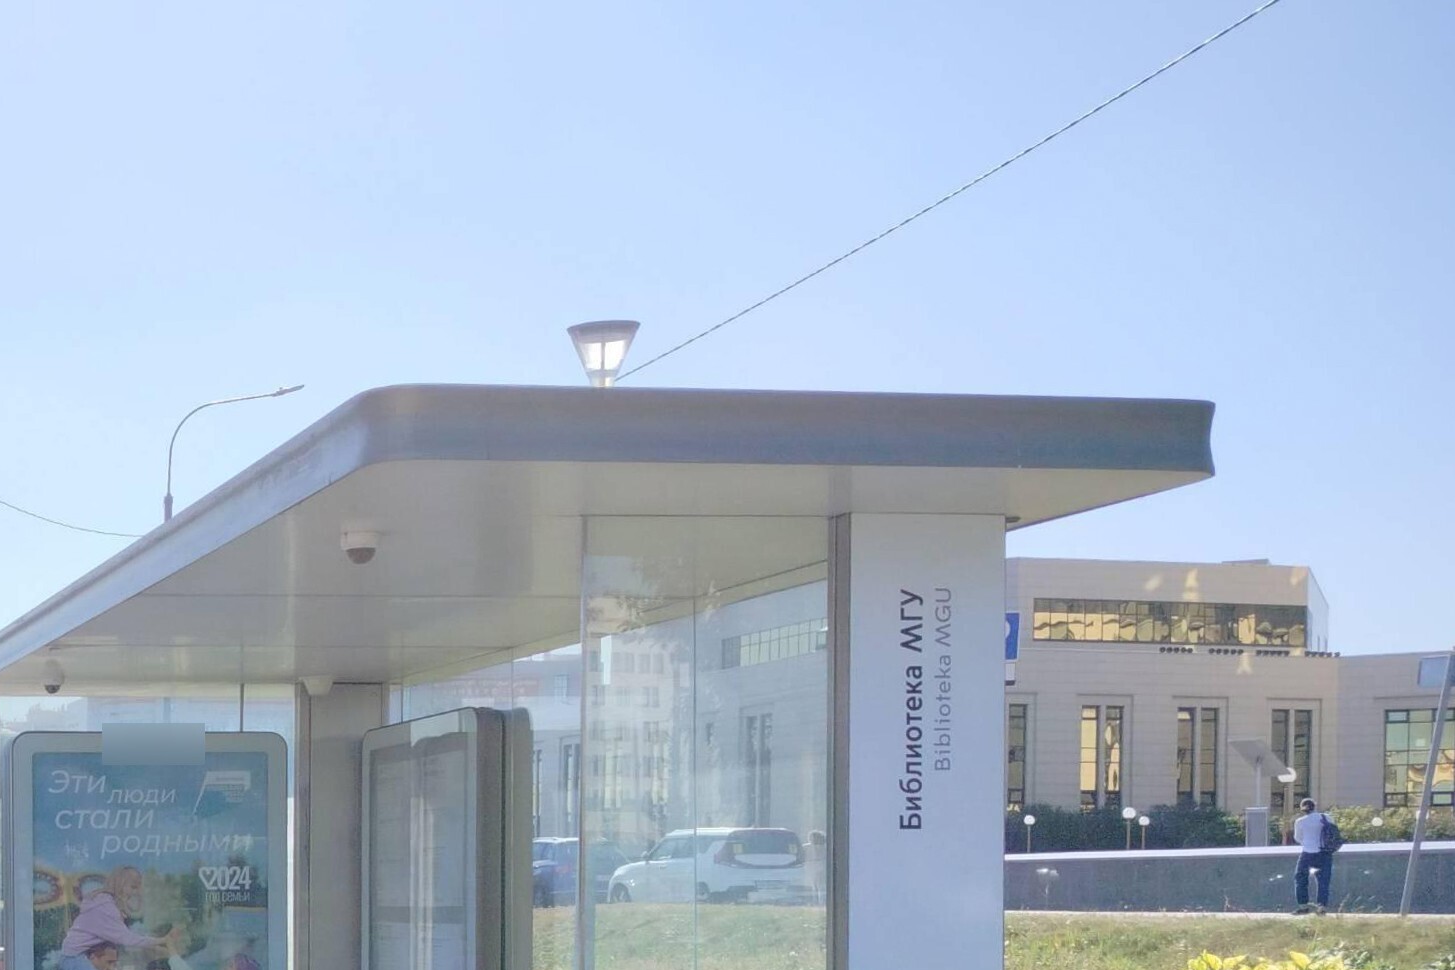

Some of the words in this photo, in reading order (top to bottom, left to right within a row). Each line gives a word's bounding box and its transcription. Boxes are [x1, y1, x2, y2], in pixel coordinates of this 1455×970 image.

[899, 588, 924, 653] МГУ
[934, 587, 952, 647] MGU
[934, 654, 951, 771] Biblioteka
[899, 665, 922, 830] Библиотека
[48, 769, 107, 794] Эти
[107, 788, 176, 805] люди
[55, 808, 154, 829] стали
[101, 834, 253, 860] родными
[198, 866, 252, 890] 2024
